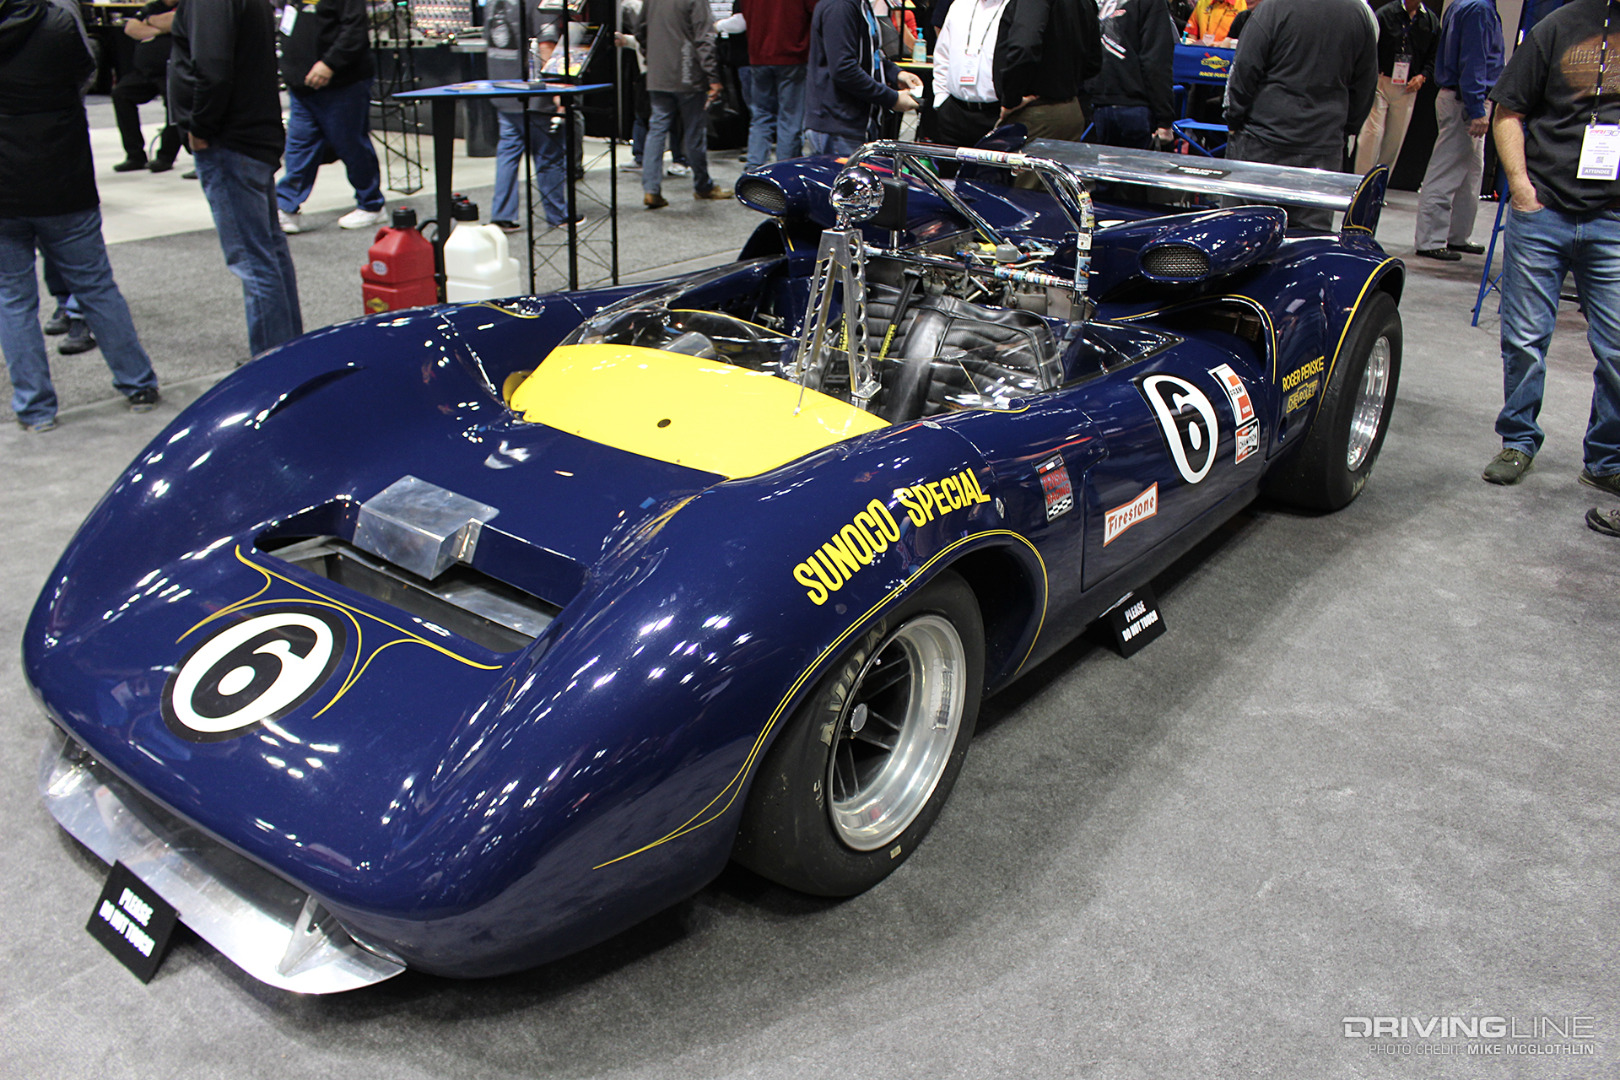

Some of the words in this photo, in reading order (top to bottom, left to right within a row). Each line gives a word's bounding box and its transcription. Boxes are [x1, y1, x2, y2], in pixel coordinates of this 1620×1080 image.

[1229, 385, 1243, 397] FRAM
[1282, 369, 1301, 392] ROGER
[1301, 355, 1325, 381] PENSKE
[1287, 382, 1317, 411] CHEVROLET
[1147, 377, 1215, 480] 6
[1238, 433, 1257, 450] CHAMPION
[1042, 466, 1069, 493] PENSKE
[1047, 483, 1071, 505] RACING
[1107, 496, 1155, 537] Firestone
[792, 498, 901, 606] SUNOCO
[893, 467, 992, 528] SPECIAL
[1121, 627, 1132, 642] DO
[1129, 620, 1142, 637] NOT
[1139, 609, 1158, 630] TOUCH
[1124, 600, 1147, 623] PLEASE
[180, 617, 326, 726] 6
[118, 887, 154, 927] PLEASE
[98, 899, 116, 922] DO
[109, 908, 131, 935] NOT
[124, 921, 156, 957] TOUCH
